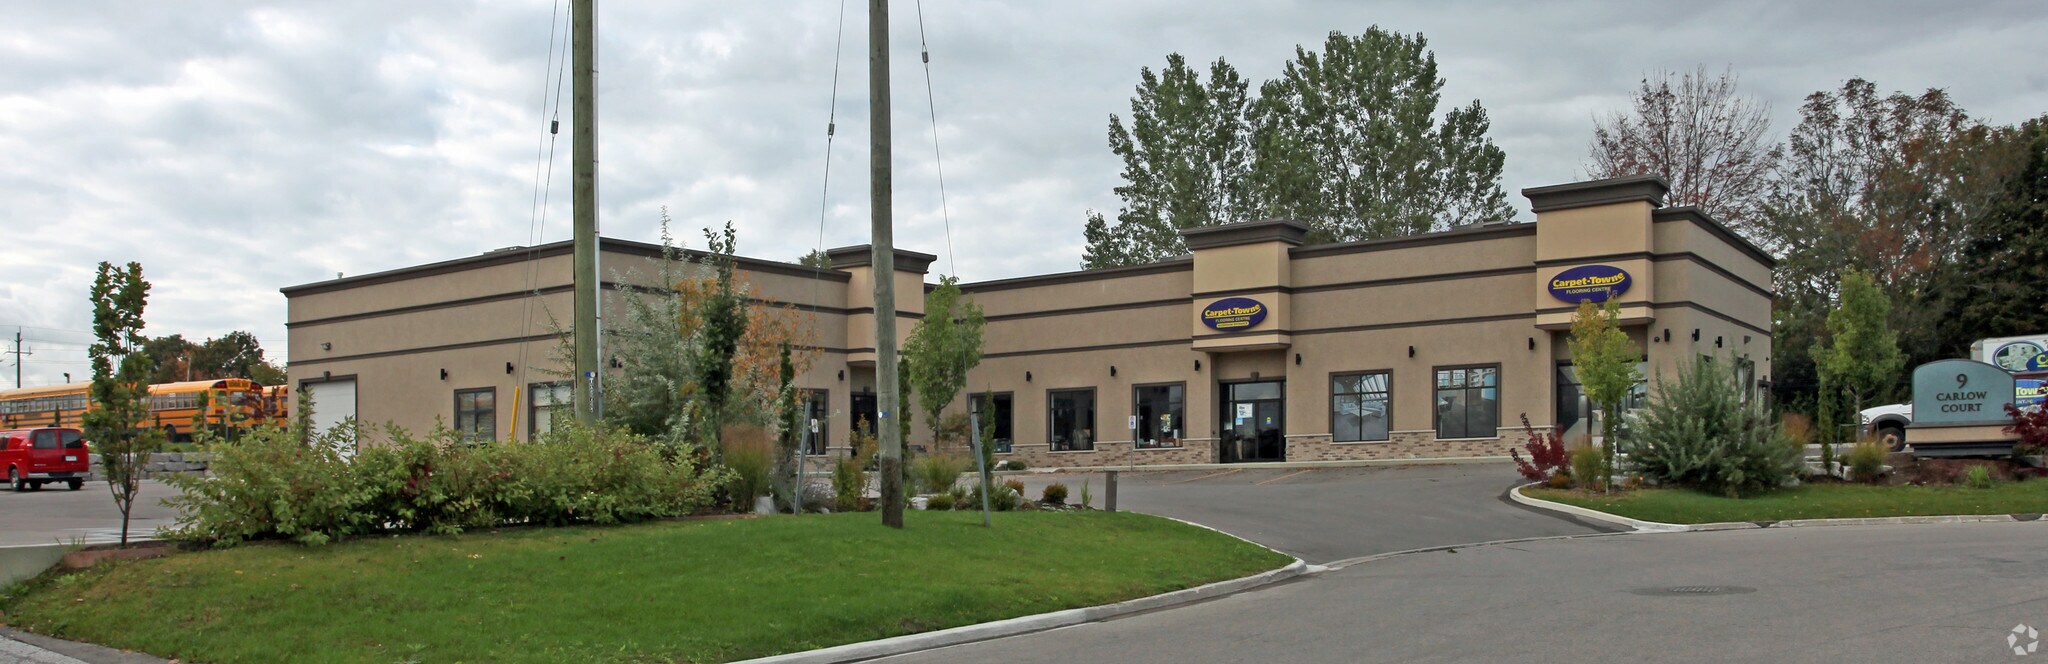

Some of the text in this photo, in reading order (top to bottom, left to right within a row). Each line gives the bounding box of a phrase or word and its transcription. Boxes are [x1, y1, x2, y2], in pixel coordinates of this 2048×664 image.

[1956, 373, 1968, 389] 9
[1936, 391, 1987, 401] CARLOW
[1941, 403, 1982, 412] COURT
